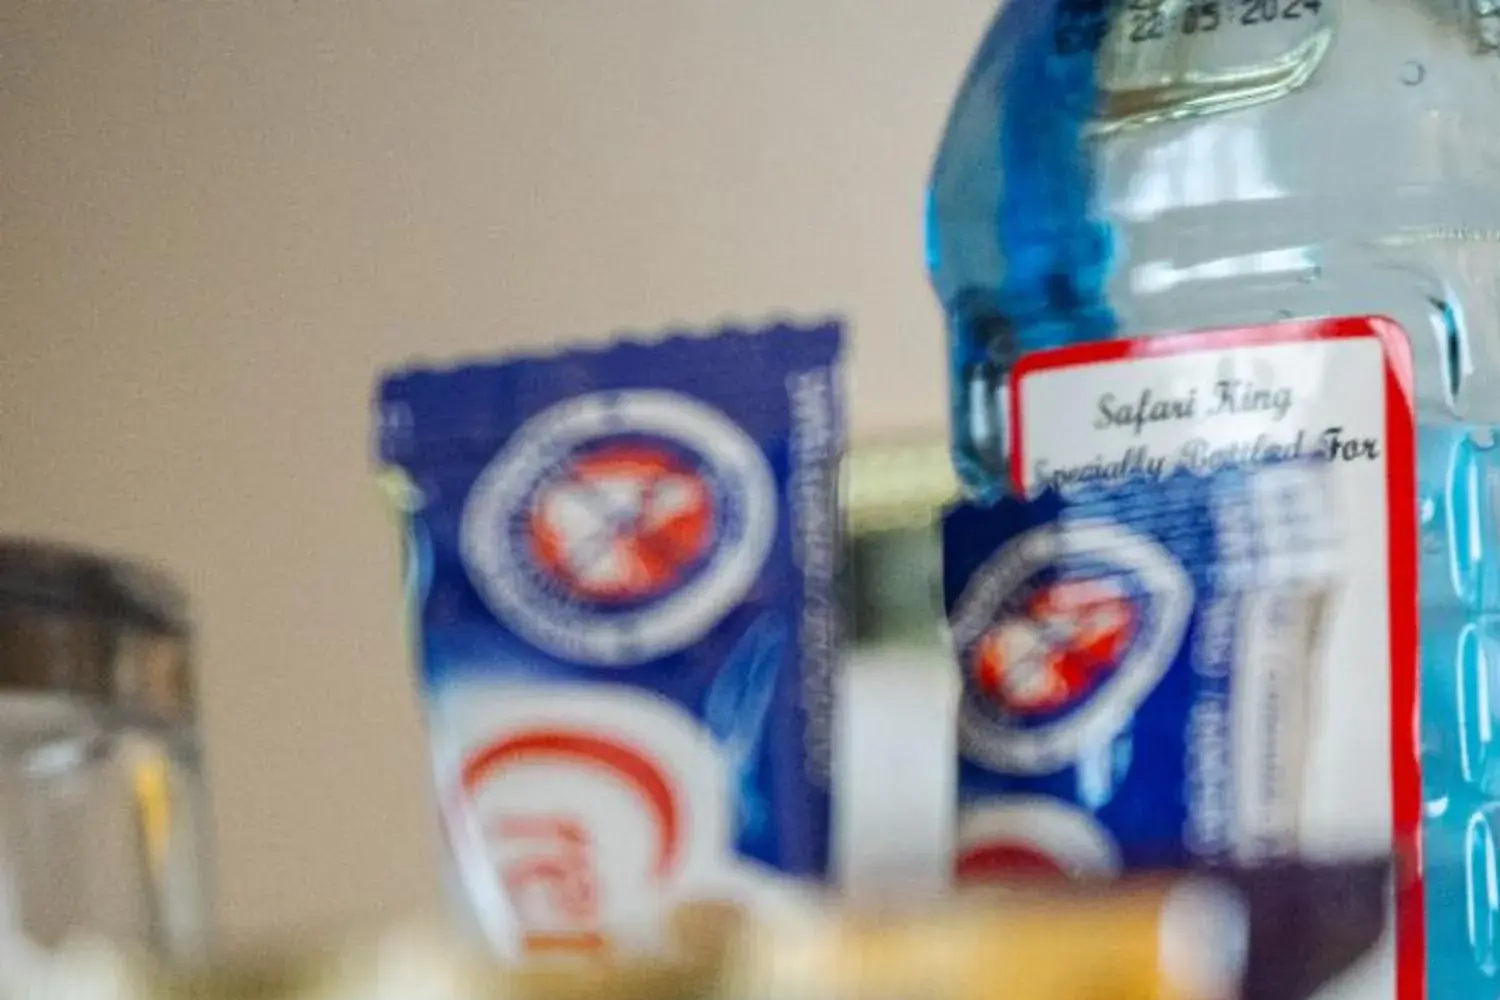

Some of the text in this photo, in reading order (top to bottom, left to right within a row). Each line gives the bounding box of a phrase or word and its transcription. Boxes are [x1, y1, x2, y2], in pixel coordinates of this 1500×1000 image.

[1094, 380, 1292, 435] Safari King
[1317, 427, 1380, 463] For
